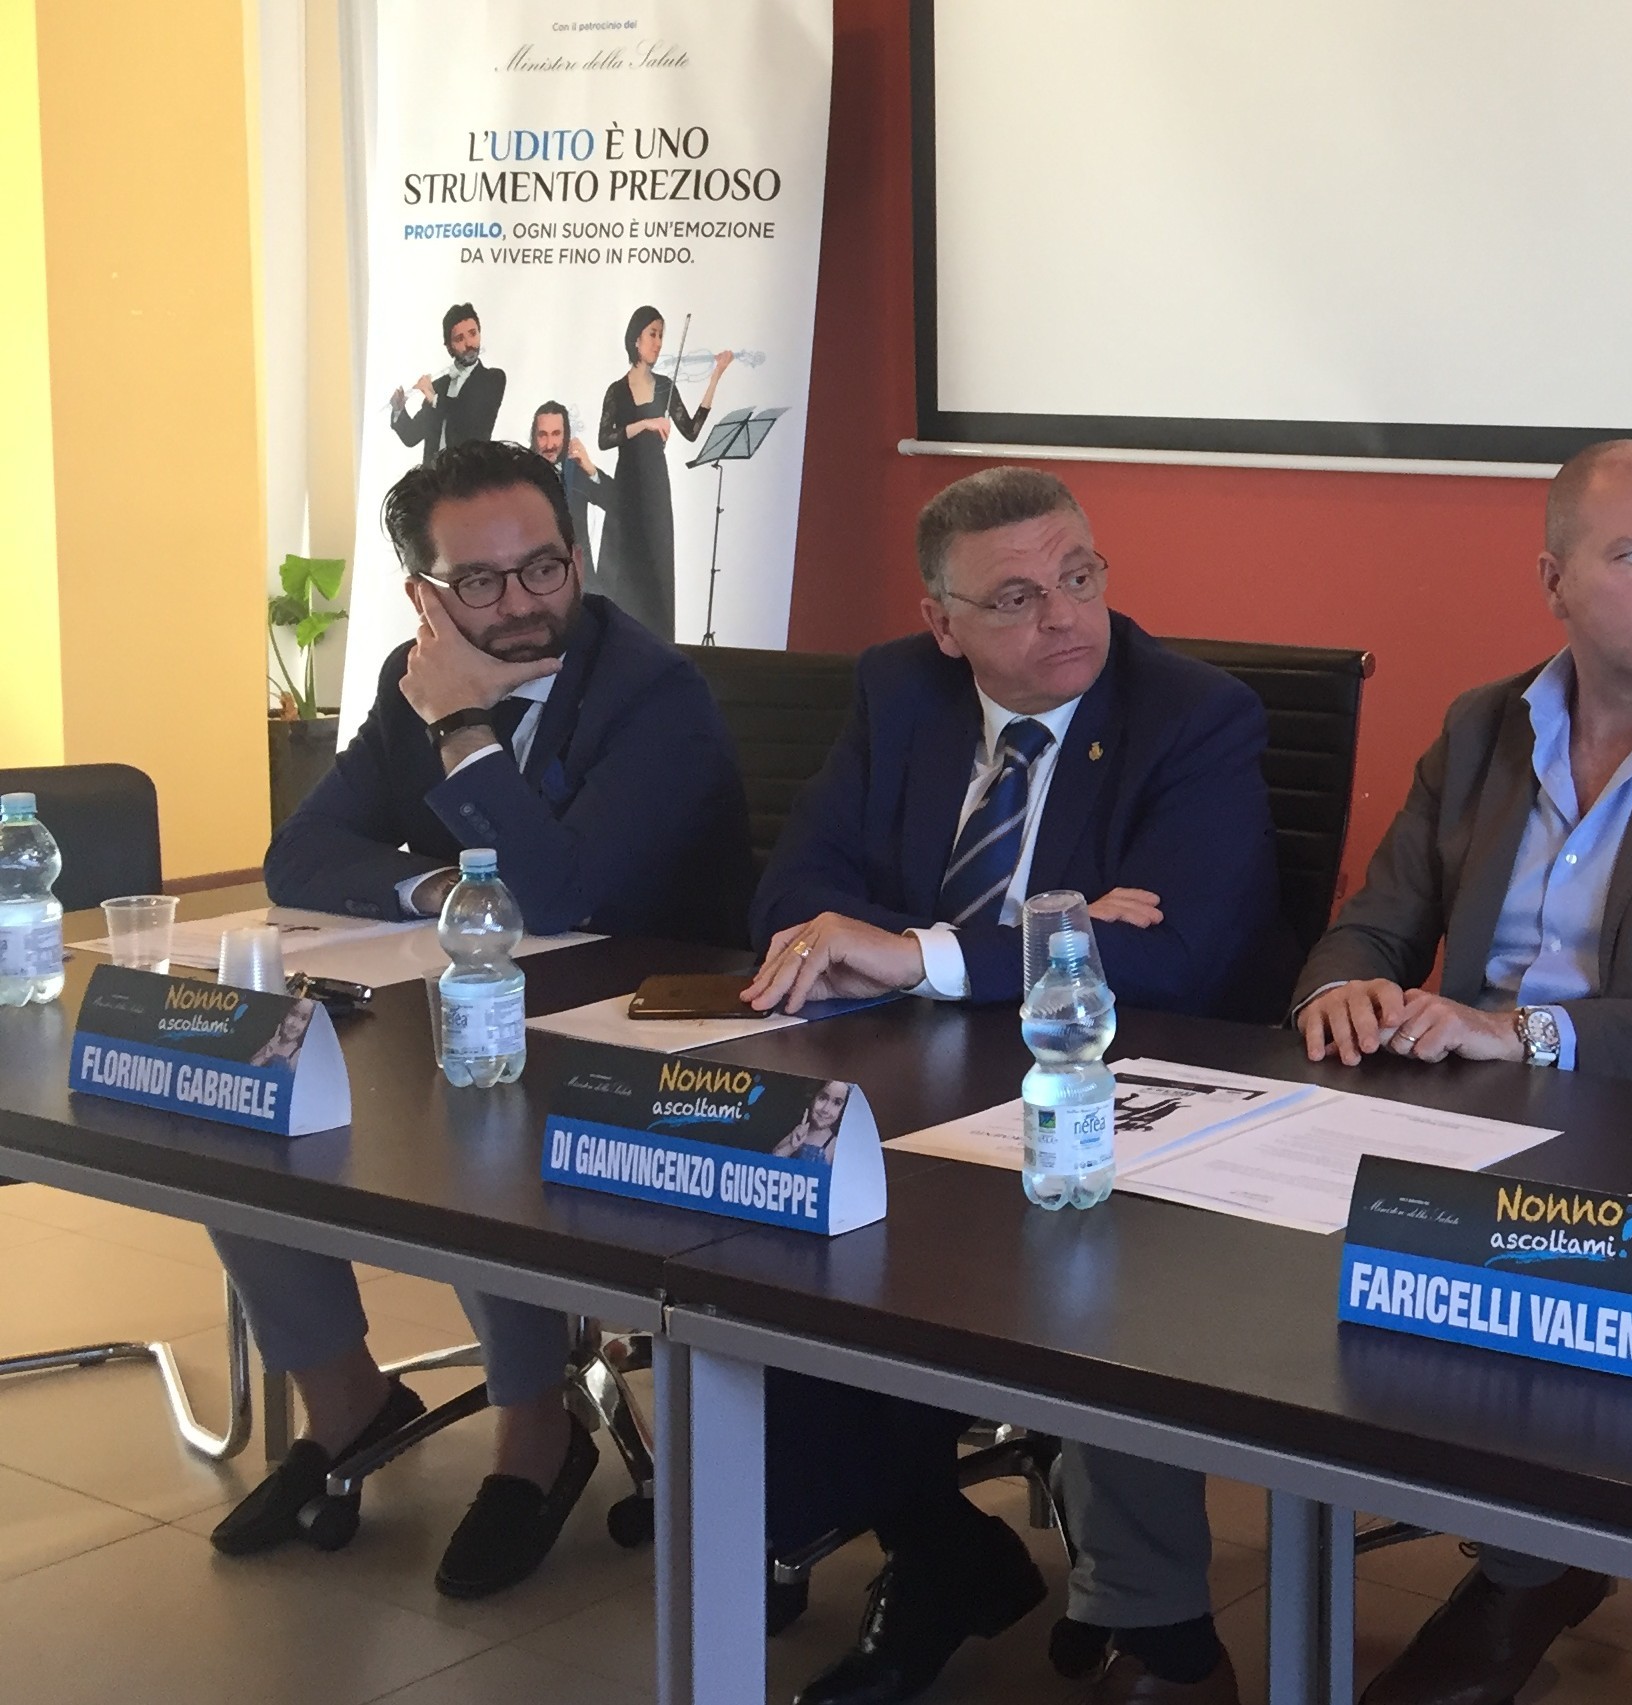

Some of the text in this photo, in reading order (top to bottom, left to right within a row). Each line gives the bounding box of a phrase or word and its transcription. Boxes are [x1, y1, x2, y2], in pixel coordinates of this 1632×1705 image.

[552, 22, 570, 32] Con
[579, 20, 622, 33] patrocinio
[581, 49, 628, 71] della
[628, 38, 690, 70] Salute
[468, 121, 709, 162] L'UDITO È UNO
[403, 167, 782, 205] STRUMENTO PREZIOSO
[404, 217, 775, 242] PROTEGGILO, OGNI SUONO È UN'EMOZIONE
[460, 246, 695, 265] DA VIVERE FINO IN FONDO.
[81, 1045, 278, 1119] FLORINDI GABRIELE
[550, 1130, 818, 1218] DI GIANVINCENZO GIUSEPPE
[1349, 1261, 1519, 1338] FARICELLI
